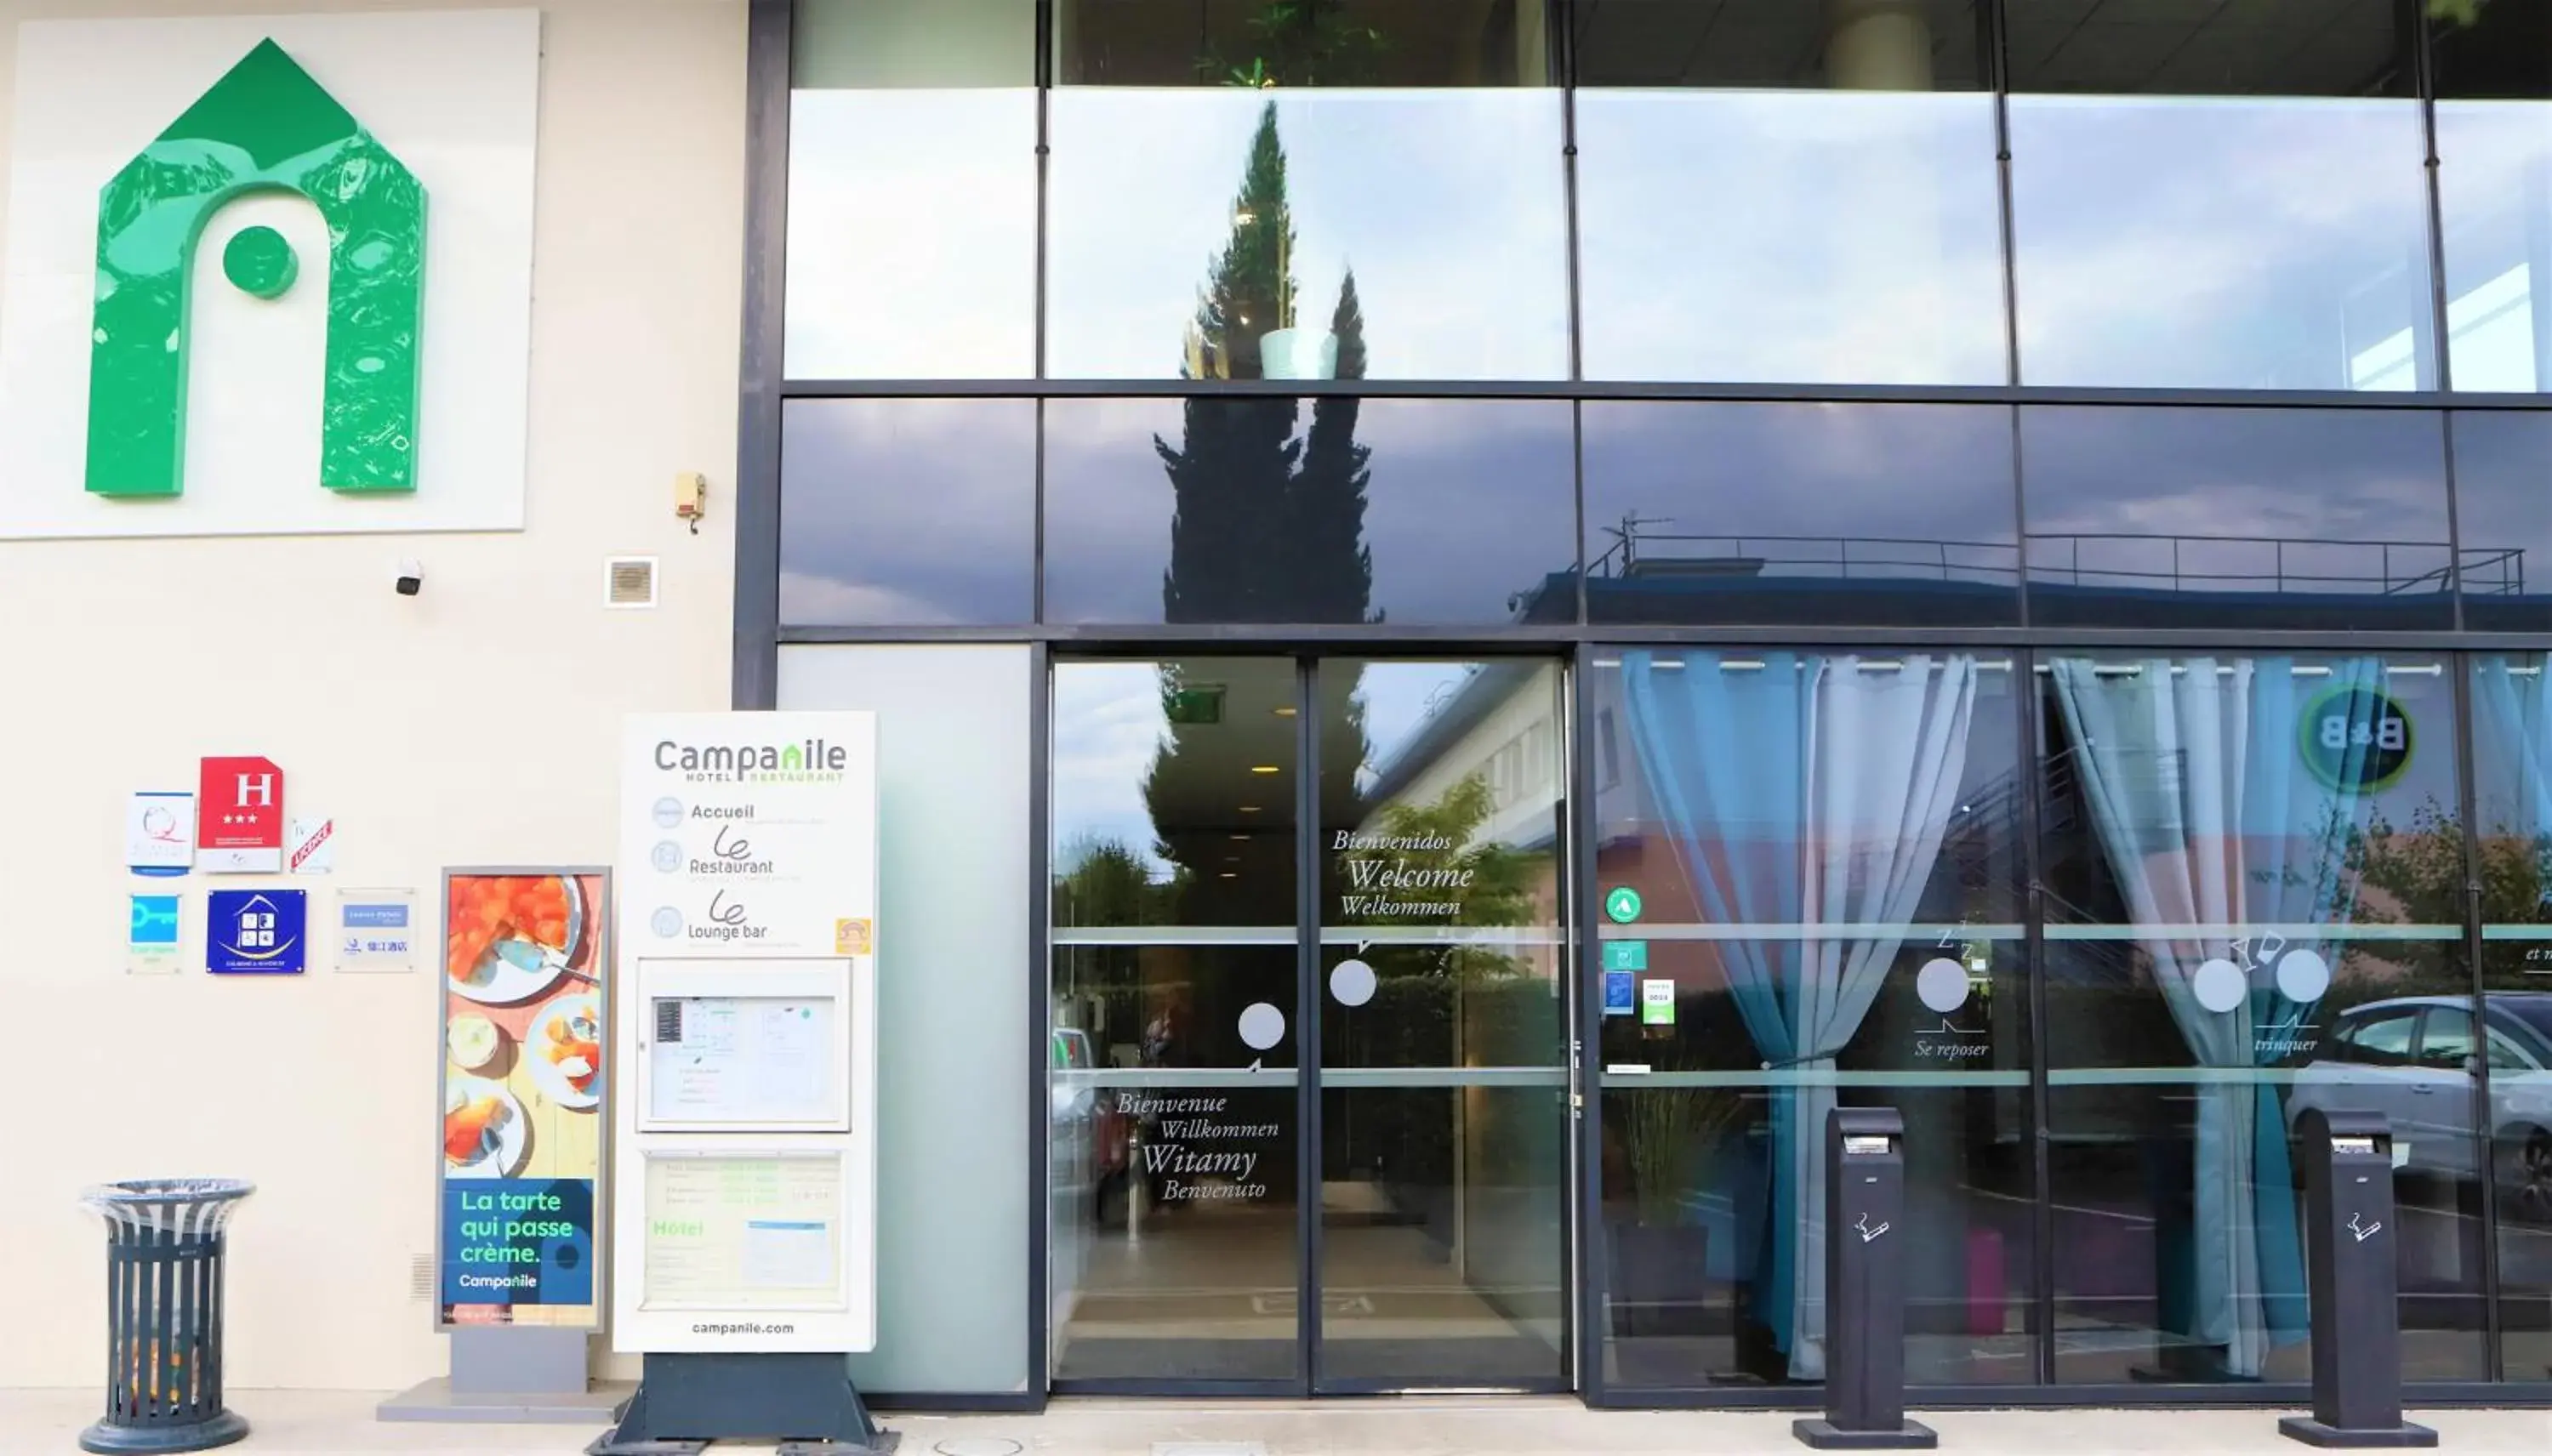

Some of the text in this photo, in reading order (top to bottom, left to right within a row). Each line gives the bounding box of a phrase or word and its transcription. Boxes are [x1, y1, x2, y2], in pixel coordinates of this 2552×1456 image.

[686, 773, 732, 782] HOTEL
[234, 772, 274, 807] H
[692, 805, 755, 818] Accueil
[714, 825, 752, 859] Le
[1332, 829, 1453, 850] Bienvenidos
[690, 860, 773, 874] Restaurant
[1349, 858, 1475, 888] Welcome
[709, 889, 747, 924] Le
[1342, 895, 1461, 916] Welkommen
[688, 924, 768, 941] Lounge bar
[1915, 1040, 1990, 1061] Se reposer
[2254, 1038, 2318, 1057] trinquer
[1117, 1093, 1228, 1114] Bienvenue
[1161, 1119, 1279, 1139] Willkommen
[1143, 1144, 1257, 1182] Witamy
[1162, 1180, 1267, 1200] Benvenuto
[462, 1192, 561, 1211] La tarte
[460, 1216, 572, 1241] qui passe
[460, 1243, 540, 1263] crème.
[459, 1274, 538, 1290] Campanile
[692, 1322, 795, 1336] campanile.com
